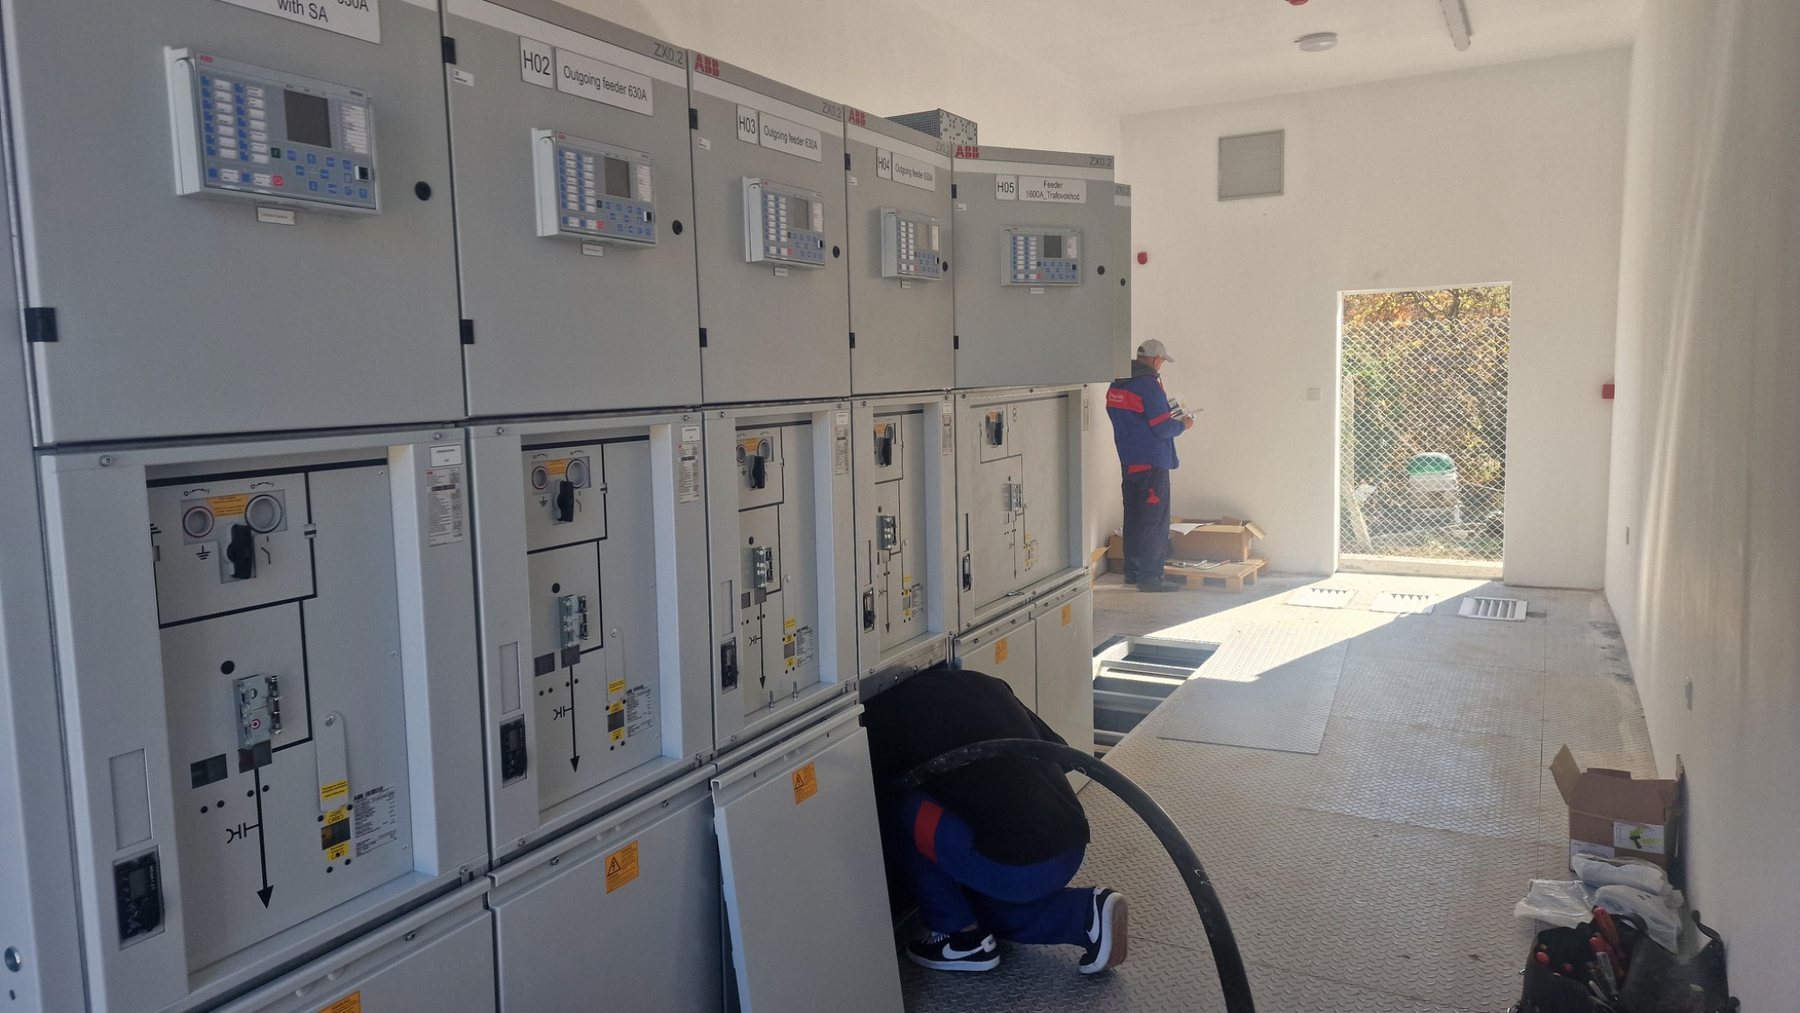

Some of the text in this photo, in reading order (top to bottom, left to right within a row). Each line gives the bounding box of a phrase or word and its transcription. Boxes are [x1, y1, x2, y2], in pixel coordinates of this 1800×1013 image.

[277, 0, 329, 23] with SA
[523, 49, 550, 76] H02
[653, 42, 684, 65] ZX0.2
[694, 53, 720, 77] ABB
[563, 65, 648, 101] Outgoing feeder 630A
[738, 115, 756, 135] H03
[849, 109, 865, 127] ABB
[763, 124, 788, 144] Outgoing
[955, 145, 980, 159] ABB
[1089, 156, 1112, 167] ZX0.2
[879, 156, 890, 171] H04
[997, 181, 1015, 193] H05
[1043, 180, 1063, 189] Feeder
